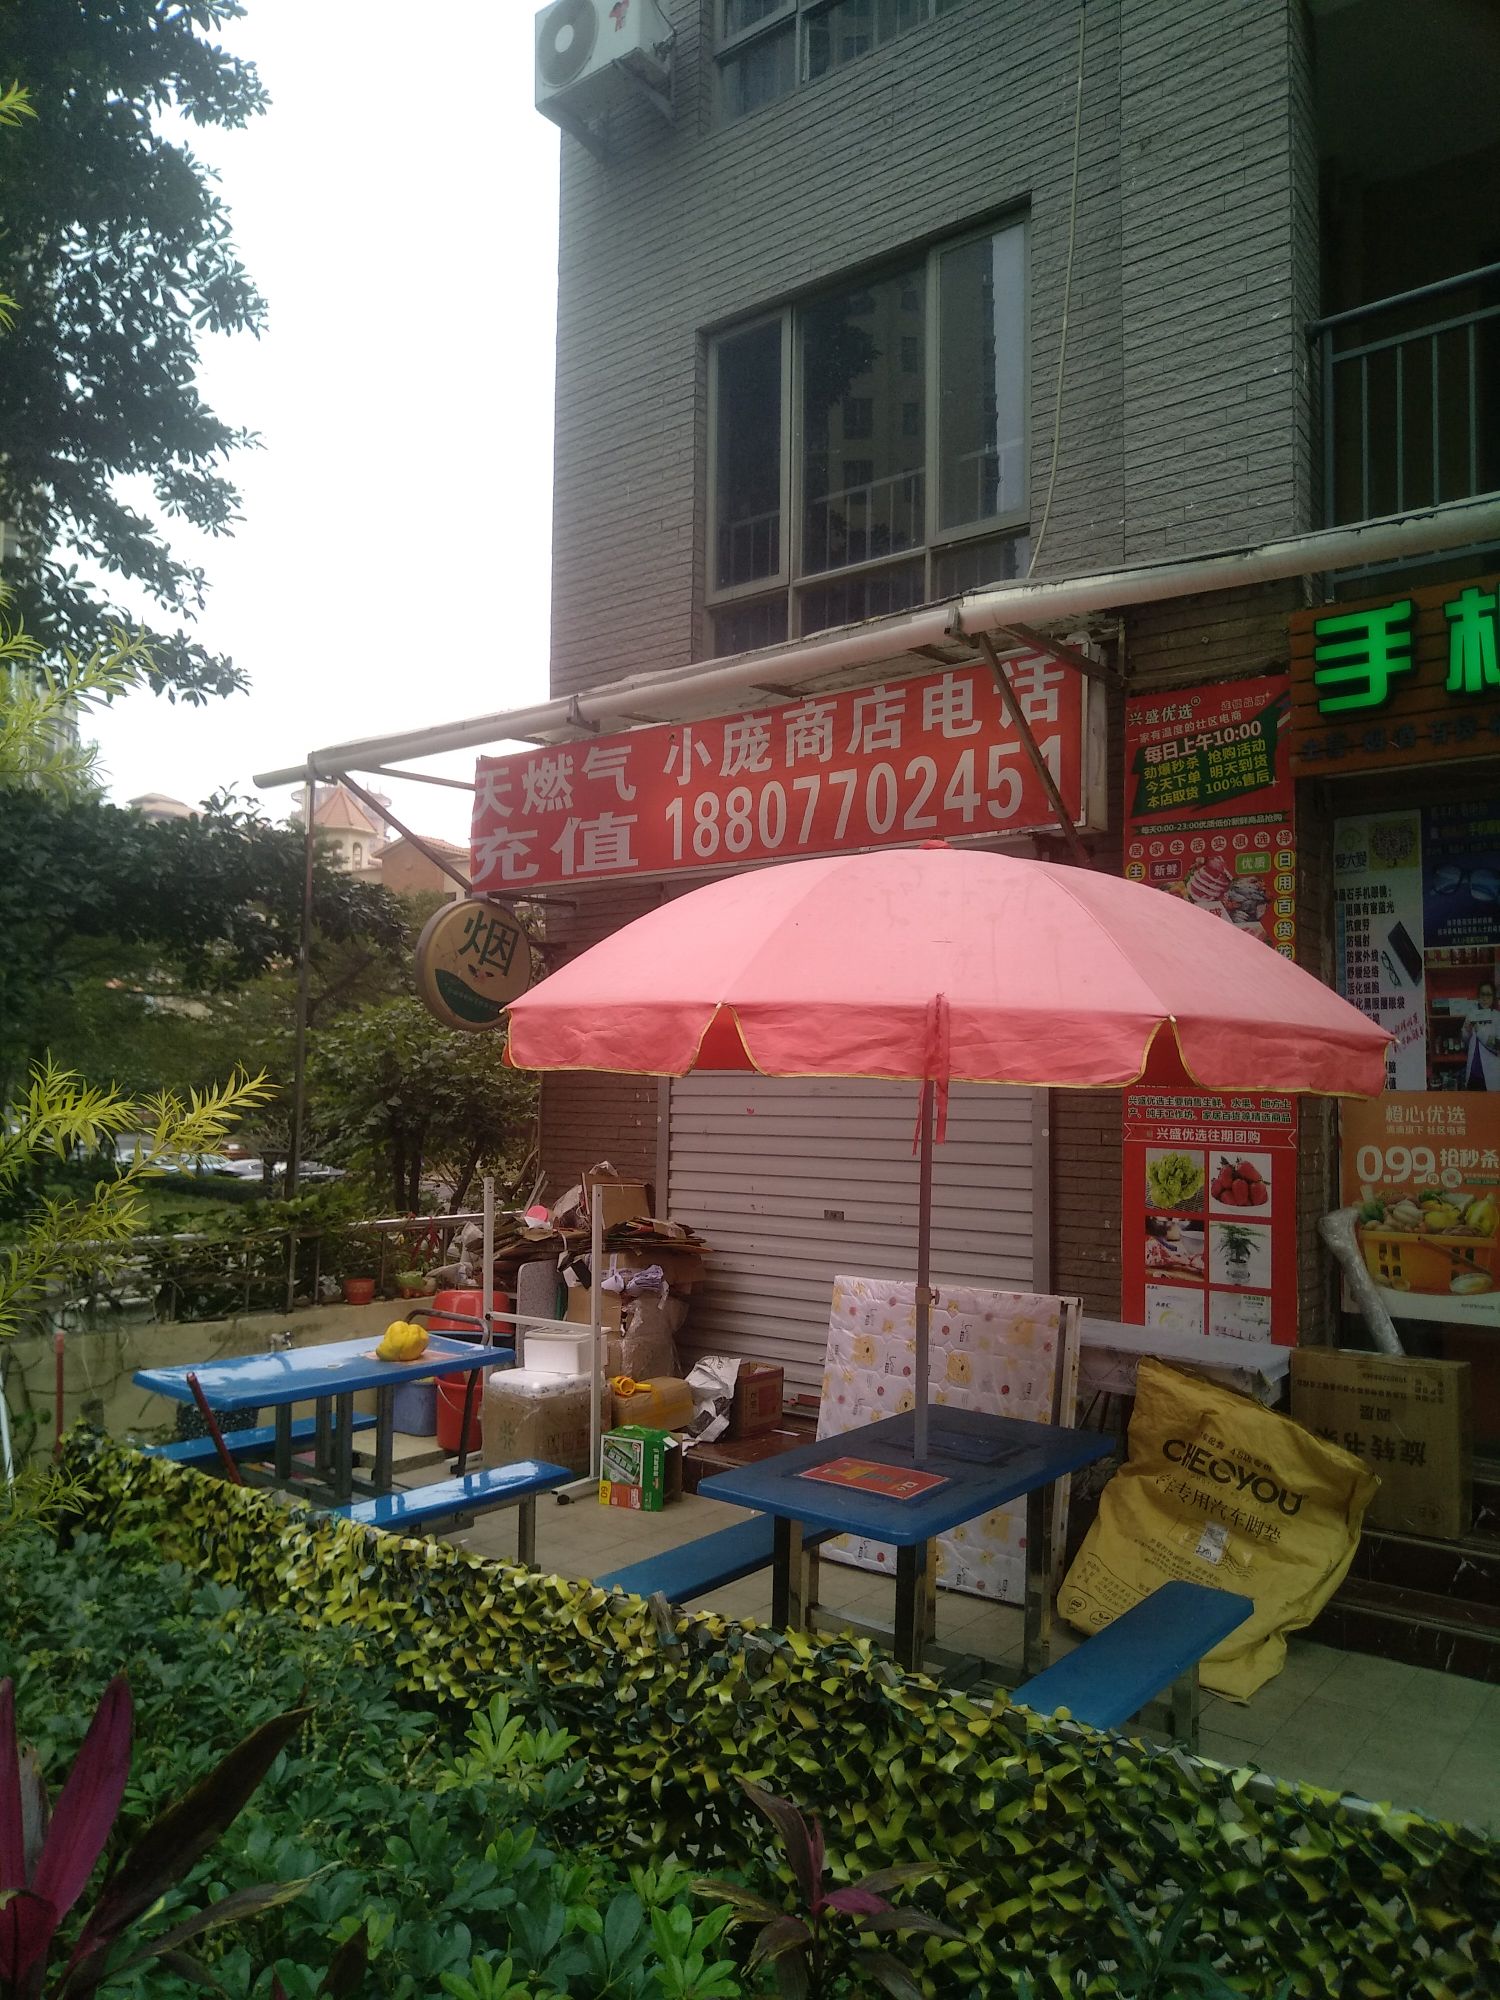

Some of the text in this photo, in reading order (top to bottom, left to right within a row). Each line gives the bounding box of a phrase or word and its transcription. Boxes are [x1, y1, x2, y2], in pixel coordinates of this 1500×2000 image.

[664, 658, 1067, 787] 小庞商店电话
[1127, 702, 1194, 727] 兴盛优选
[1143, 720, 1263, 765] 每日上午10:00
[1143, 738, 1267, 780] 劲爆秒杀 抢购活动
[475, 744, 637, 820] 天燃气
[1145, 754, 1269, 794] 今天下单 明天到货
[1146, 770, 1271, 809] 本店取货 100%售后
[664, 735, 1063, 861] 18807702451
[472, 810, 639, 882] 充值
[1154, 864, 1178, 878] 新鲜
[458, 910, 520, 977] 烟
[1386, 1105, 1466, 1123] 橙心优选
[1156, 1127, 1261, 1144] 兴盛优选往期团购
[1357, 1145, 1436, 1183] 0.99
[1440, 1147, 1500, 1168] 抢秒杀
